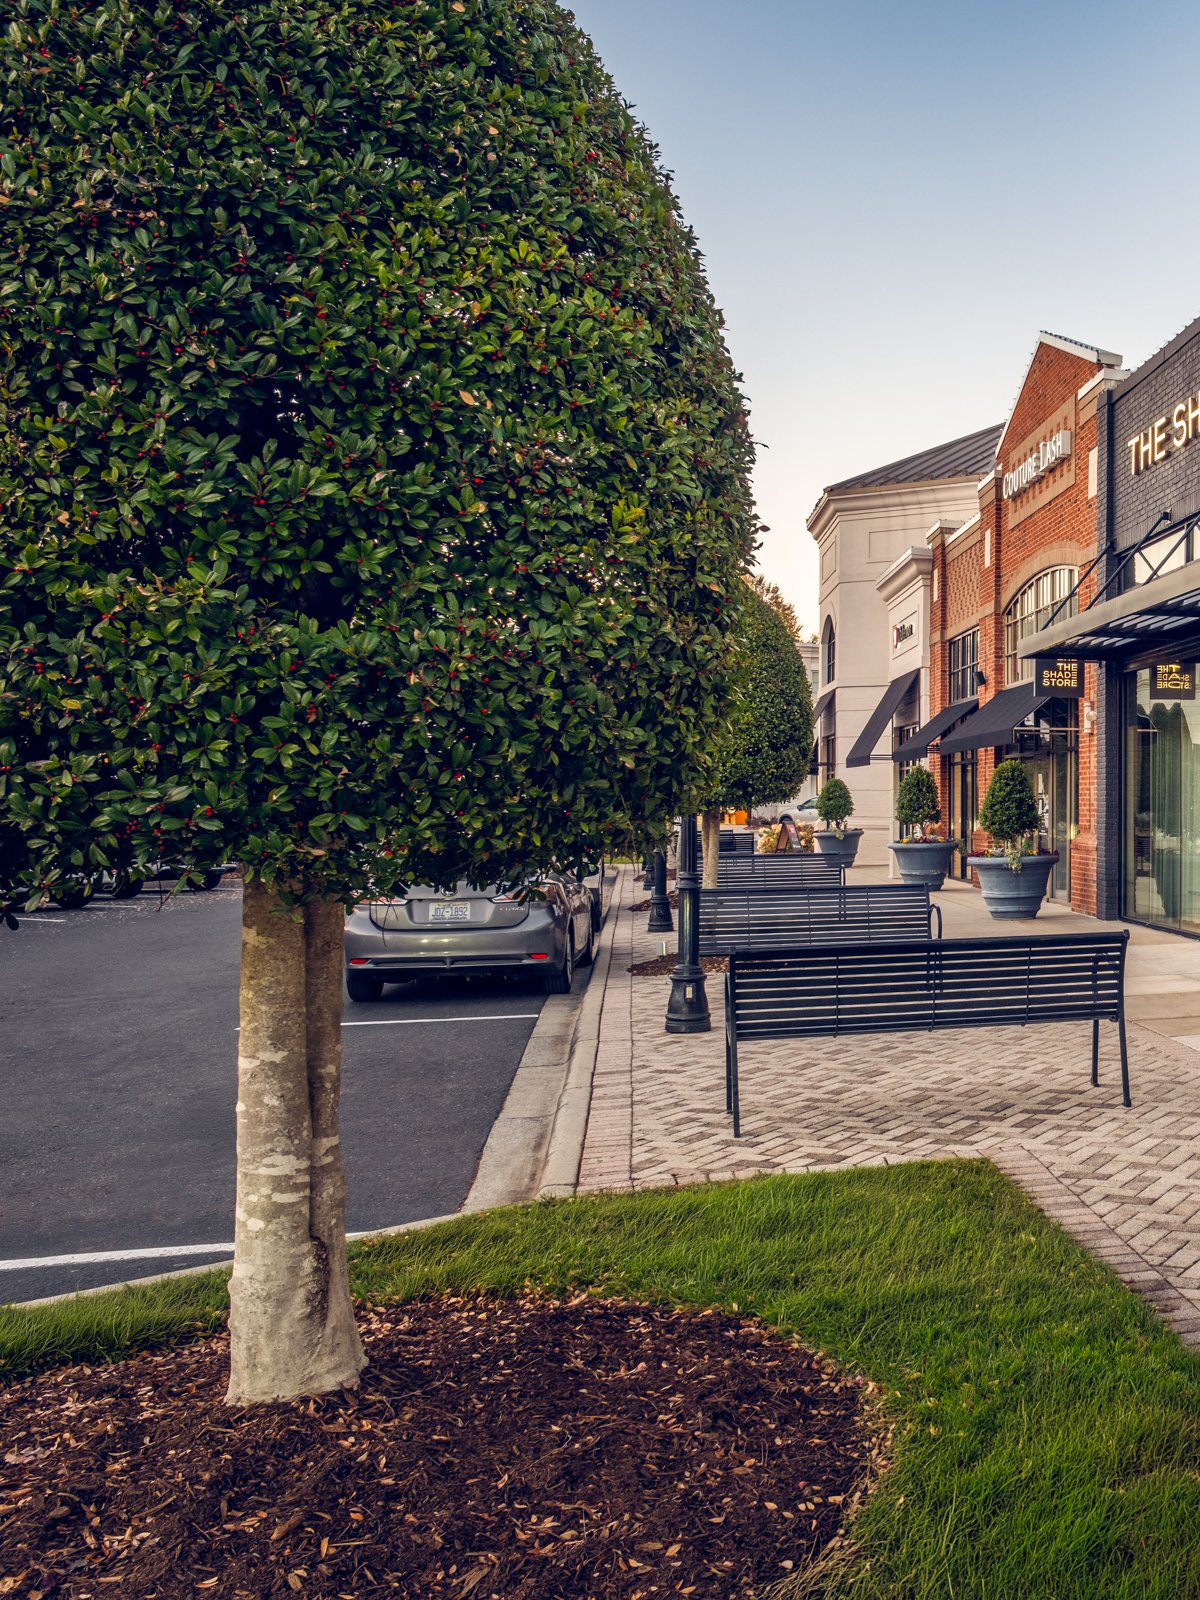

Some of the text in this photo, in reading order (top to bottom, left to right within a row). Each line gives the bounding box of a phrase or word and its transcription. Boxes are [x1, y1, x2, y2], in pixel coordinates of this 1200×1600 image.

[1127, 416, 1168, 476] THE
[1003, 429, 1064, 500] COUTURE LASH
[1056, 662, 1078, 671] THE
[1042, 670, 1078, 679] SHADE
[1042, 679, 1078, 687] STORE
